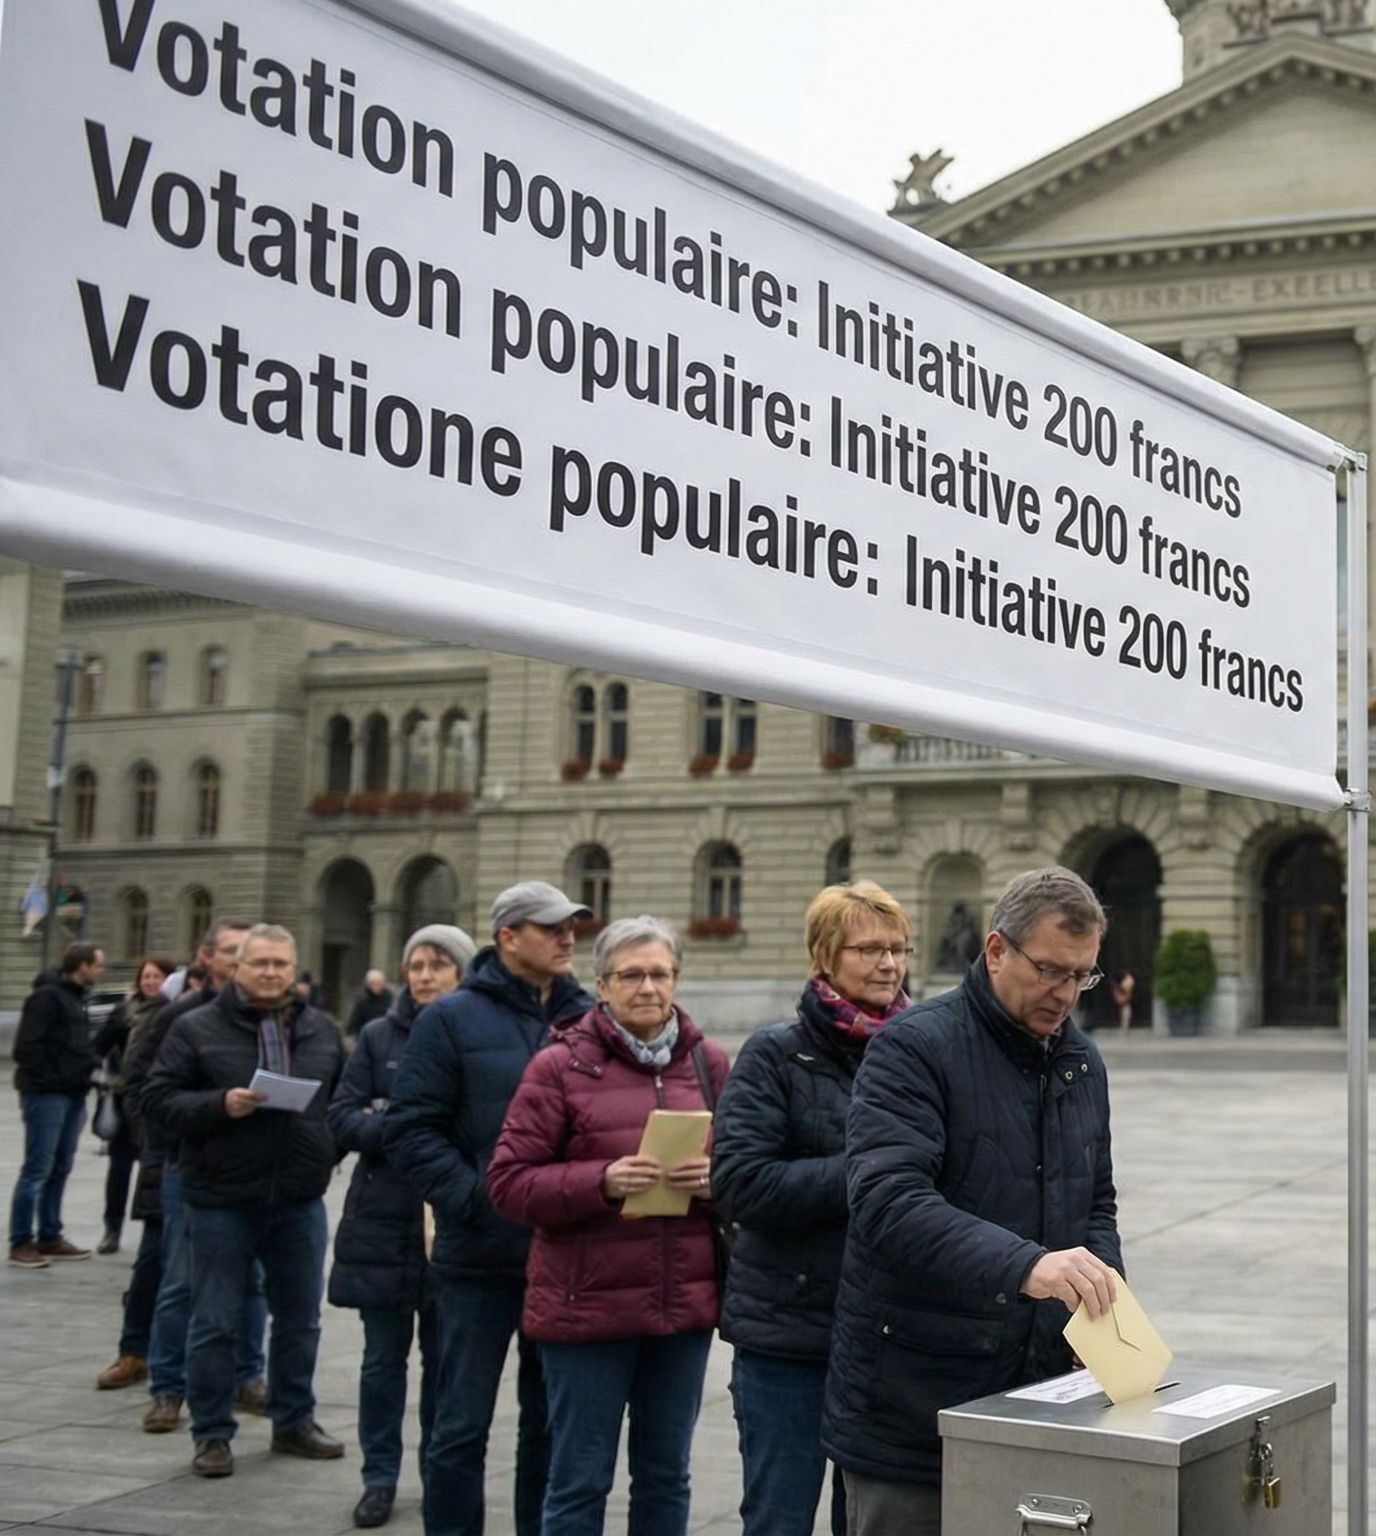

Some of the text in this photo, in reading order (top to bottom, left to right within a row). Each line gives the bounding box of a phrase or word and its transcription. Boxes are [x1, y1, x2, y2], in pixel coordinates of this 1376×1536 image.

[76, 278, 1303, 713] Votatione populaire: Initiative 200 francs
[84, 118, 1250, 609] Votation populaire: Initiative 200 francs
[97, 0, 1241, 518] Votation populaire: Initiative 200 francs
